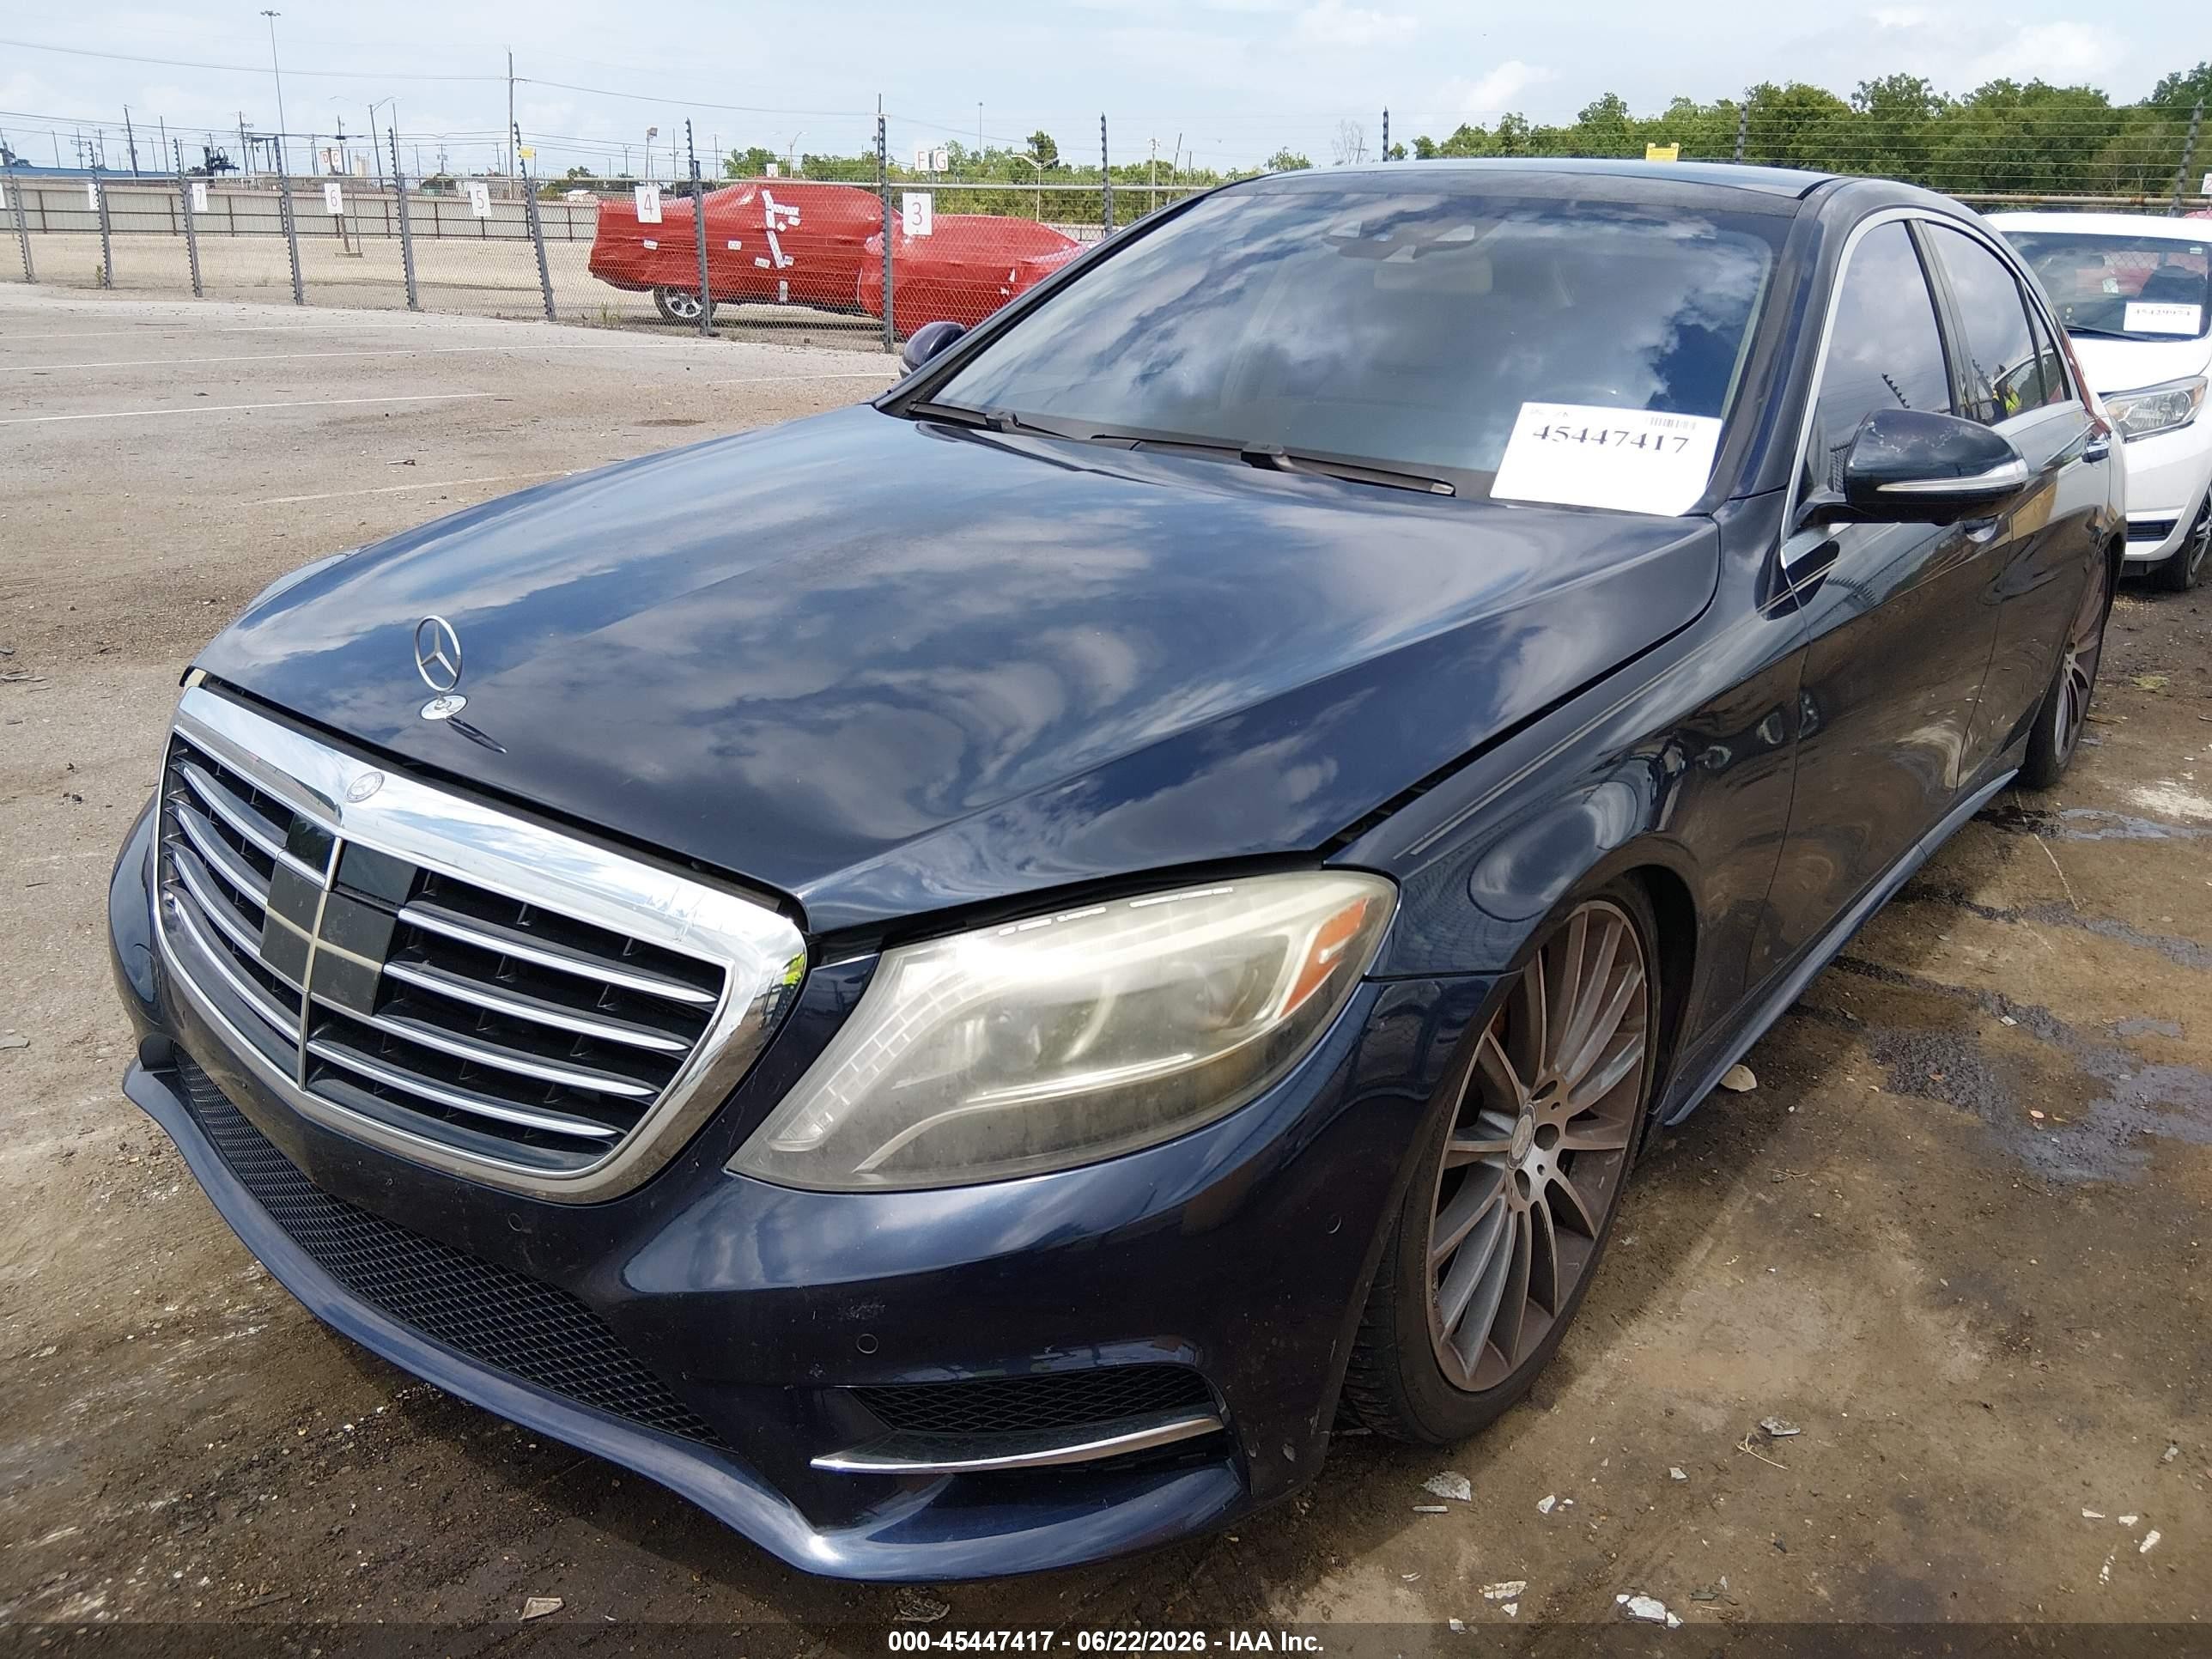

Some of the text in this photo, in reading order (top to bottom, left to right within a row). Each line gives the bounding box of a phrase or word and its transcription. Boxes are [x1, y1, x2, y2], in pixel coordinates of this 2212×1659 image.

[322, 153, 329, 163] D
[333, 152, 339, 163] C
[917, 150, 926, 170] F
[935, 151, 946, 170] G
[197, 189, 203, 206] 7
[330, 189, 338, 208] 6
[476, 190, 485, 210] 5
[643, 193, 654, 216] 4
[911, 201, 924, 226] 3
[1532, 424, 1691, 454] 45447417
